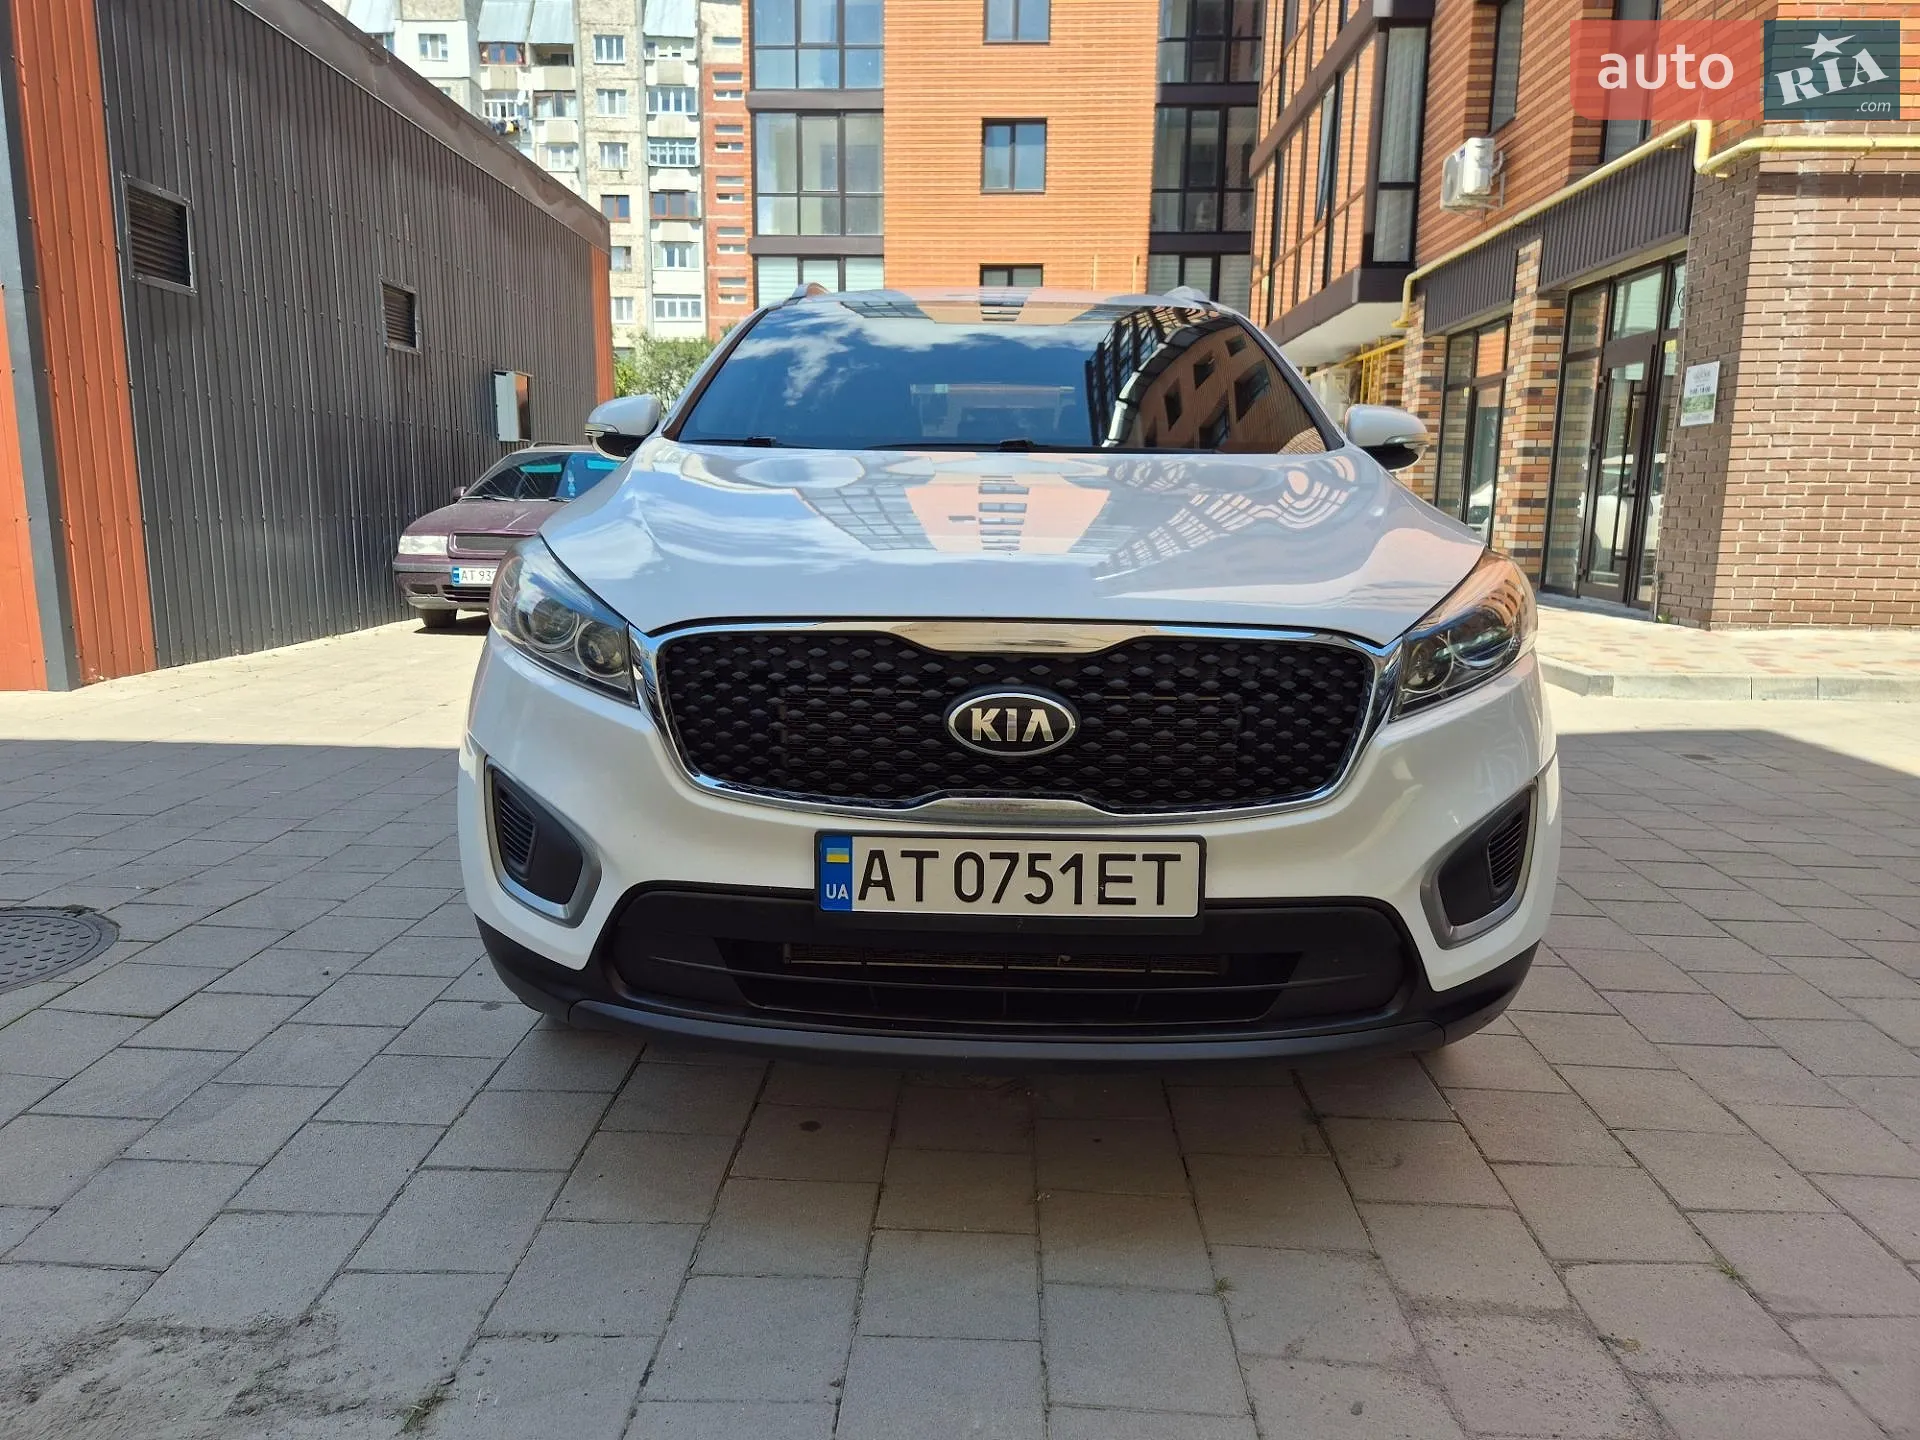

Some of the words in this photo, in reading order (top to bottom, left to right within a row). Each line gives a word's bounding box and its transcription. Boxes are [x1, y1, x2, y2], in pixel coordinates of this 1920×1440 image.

[461, 570, 476, 581] AT
[970, 708, 1055, 742] KIA
[857, 850, 940, 903] AT
[826, 883, 849, 900] UA
